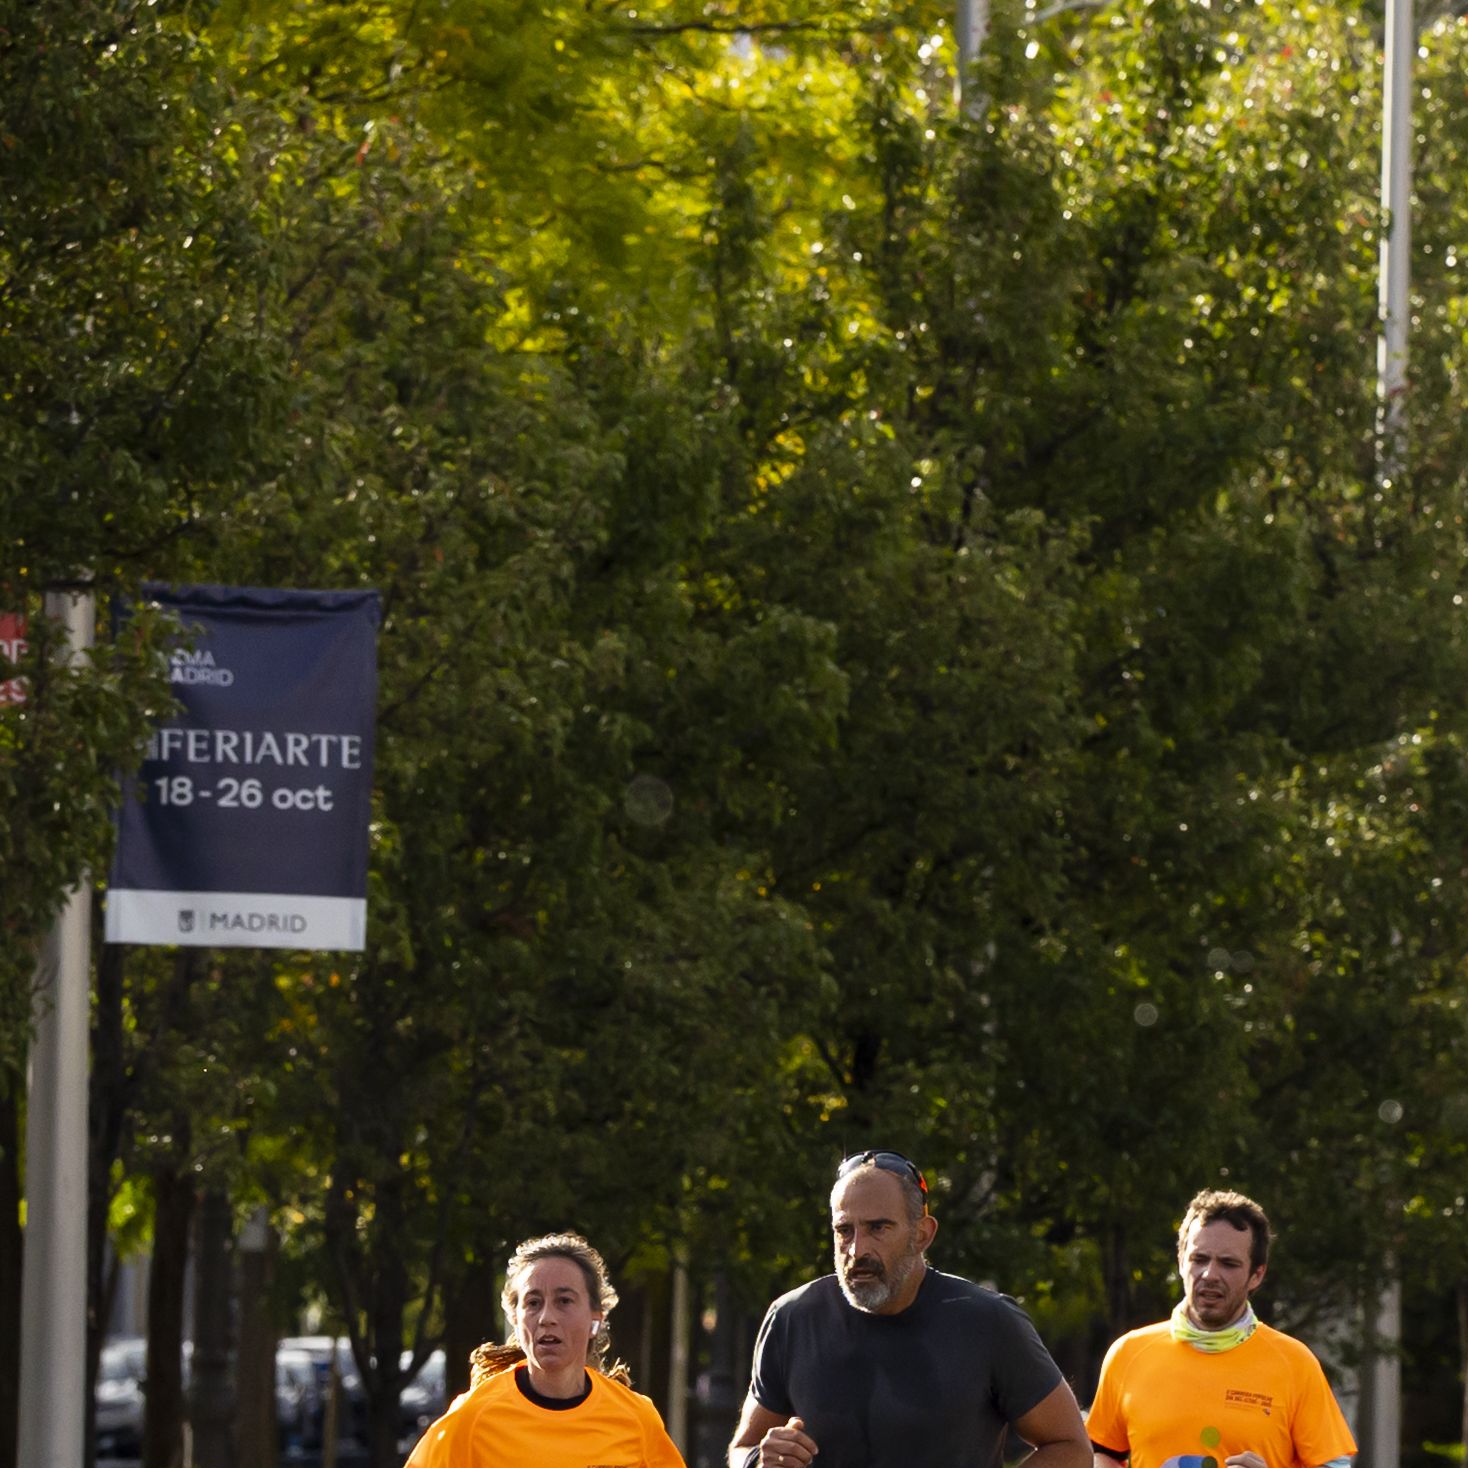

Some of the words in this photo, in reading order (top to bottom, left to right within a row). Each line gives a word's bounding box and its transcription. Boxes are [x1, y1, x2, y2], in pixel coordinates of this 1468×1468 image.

[161, 728, 362, 769] FERIARTE
[272, 785, 334, 812] oct
[209, 912, 307, 933] MADRID
